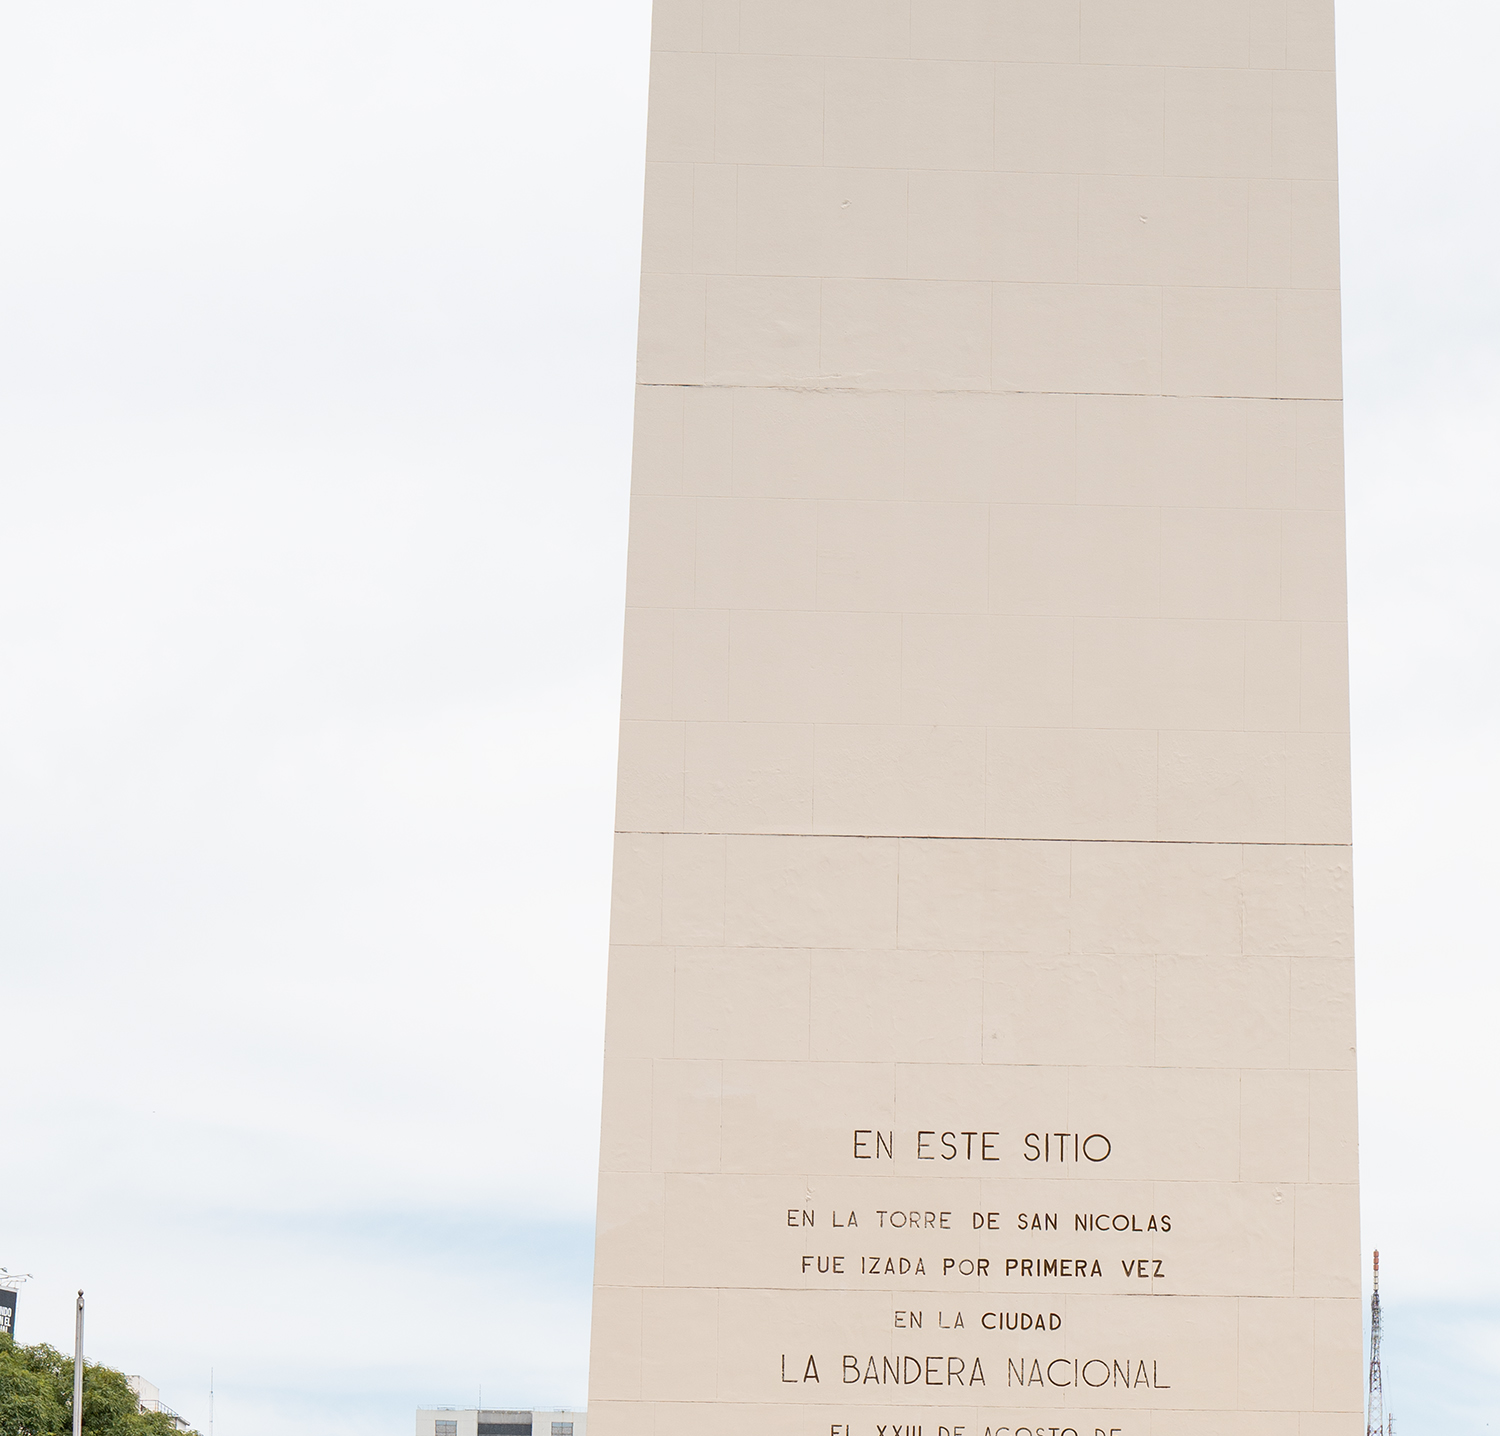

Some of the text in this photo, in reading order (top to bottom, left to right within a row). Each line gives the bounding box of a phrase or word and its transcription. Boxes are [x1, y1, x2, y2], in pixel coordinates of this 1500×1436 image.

[854, 1130, 1111, 1162] EN ESTE SITIO
[788, 1209, 1171, 1232] EN LA TORRE DE SAN NICOLAS
[802, 1256, 1165, 1278] FUE IZADA POR PRIMERA VEZ
[895, 1311, 1061, 1331] EN LA CIUDAD
[782, 1354, 1171, 1388] LA BANDERA NACIONAL
